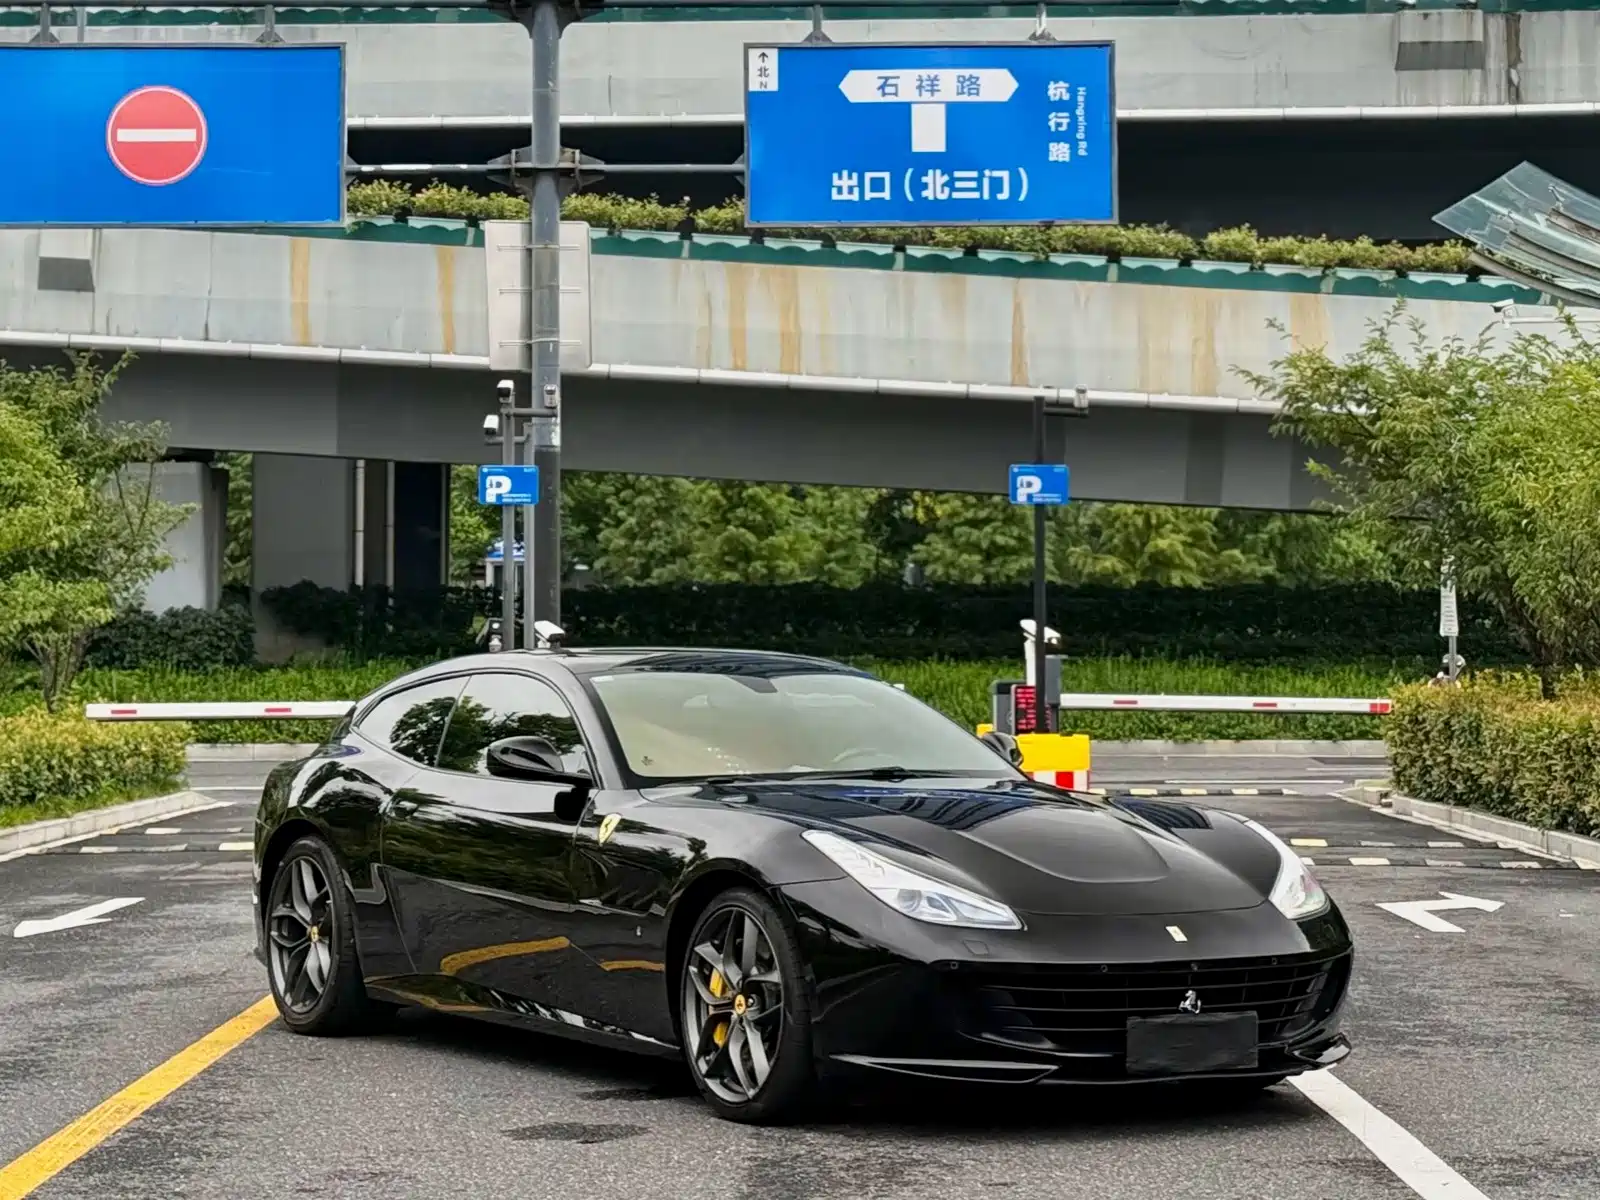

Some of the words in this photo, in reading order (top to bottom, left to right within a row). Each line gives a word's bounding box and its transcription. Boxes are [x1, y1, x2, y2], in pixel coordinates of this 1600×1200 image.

[757, 65, 770, 78] 北
[759, 81, 768, 89] N
[876, 74, 981, 98] 石祥路
[1047, 80, 1071, 162] 杭行路
[1075, 86, 1087, 140] Hangxing
[1077, 141, 1088, 155] Rd
